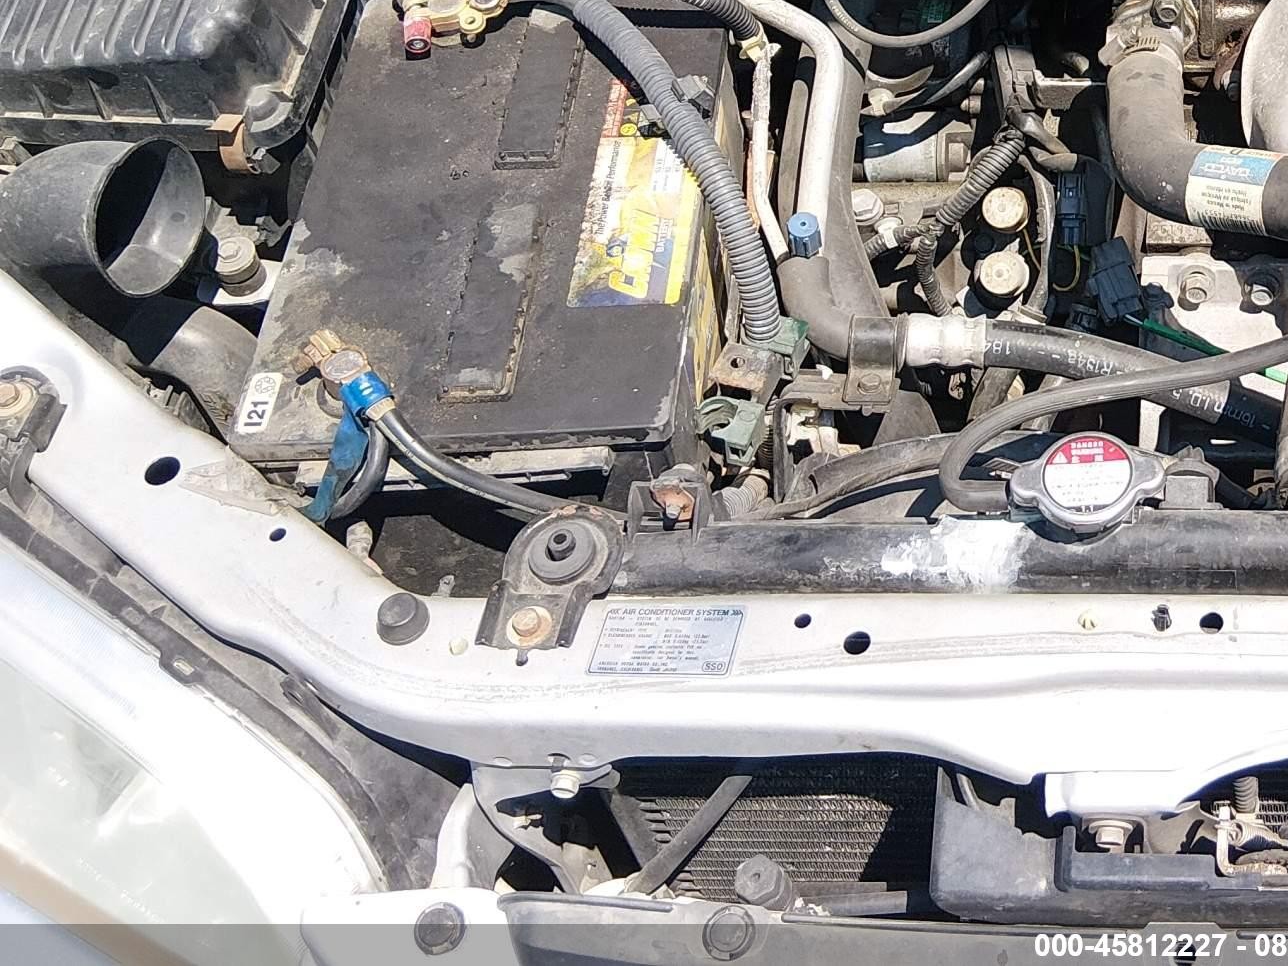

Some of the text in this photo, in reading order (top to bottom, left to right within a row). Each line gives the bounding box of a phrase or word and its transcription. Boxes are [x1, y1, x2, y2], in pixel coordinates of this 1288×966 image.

[598, 202, 611, 223] Power
[606, 140, 622, 180] Performance
[1203, 163, 1249, 176] DAYCO
